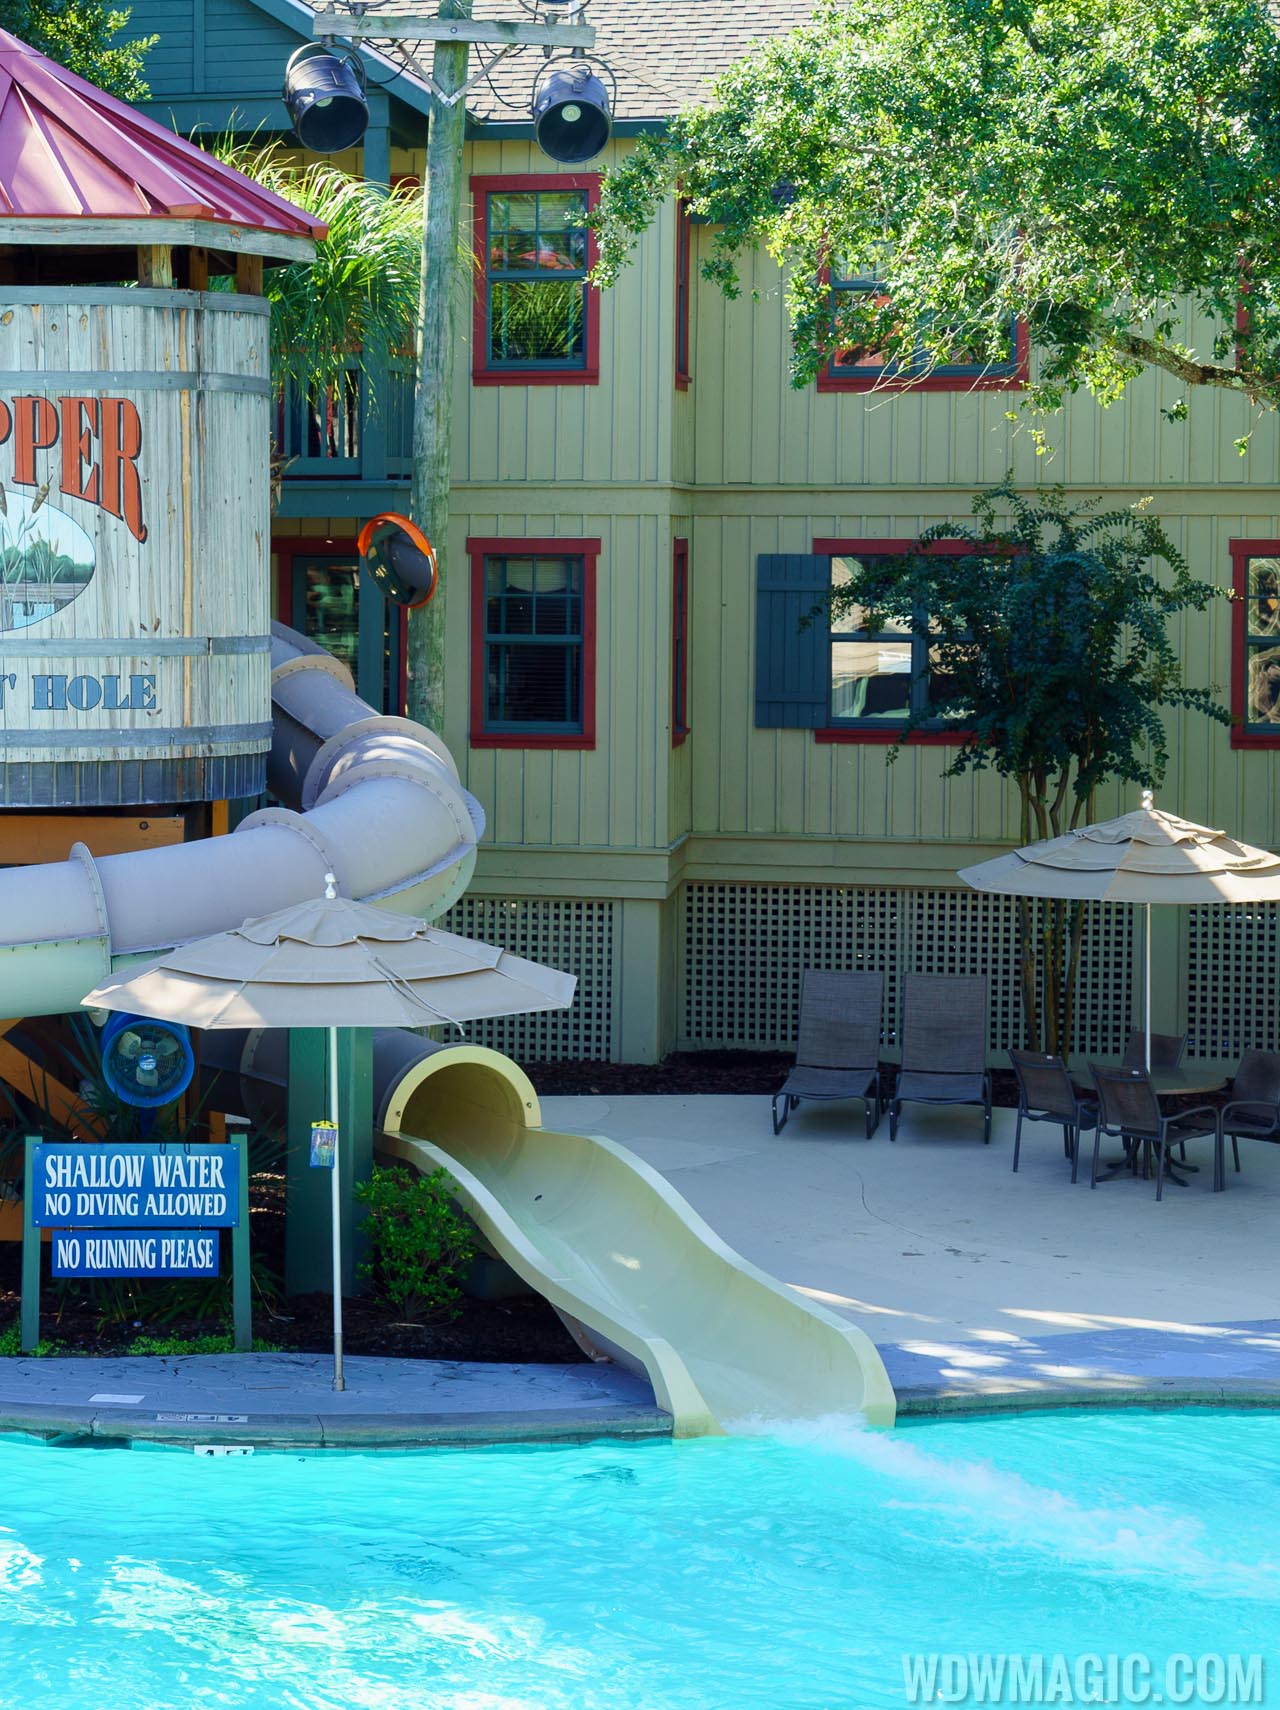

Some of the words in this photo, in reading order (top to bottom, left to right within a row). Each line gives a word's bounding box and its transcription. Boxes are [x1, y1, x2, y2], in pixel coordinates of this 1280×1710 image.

[31, 674, 157, 711] HOLE
[45, 1154, 145, 1189] SHALLOW
[152, 1155, 226, 1189] WATER
[45, 1193, 71, 1216] NO
[76, 1193, 139, 1216] DIVING
[144, 1193, 227, 1216] ALLOWED
[57, 1238, 80, 1269] NO
[85, 1238, 156, 1270] RUNNING
[161, 1238, 214, 1269] PLEASE
